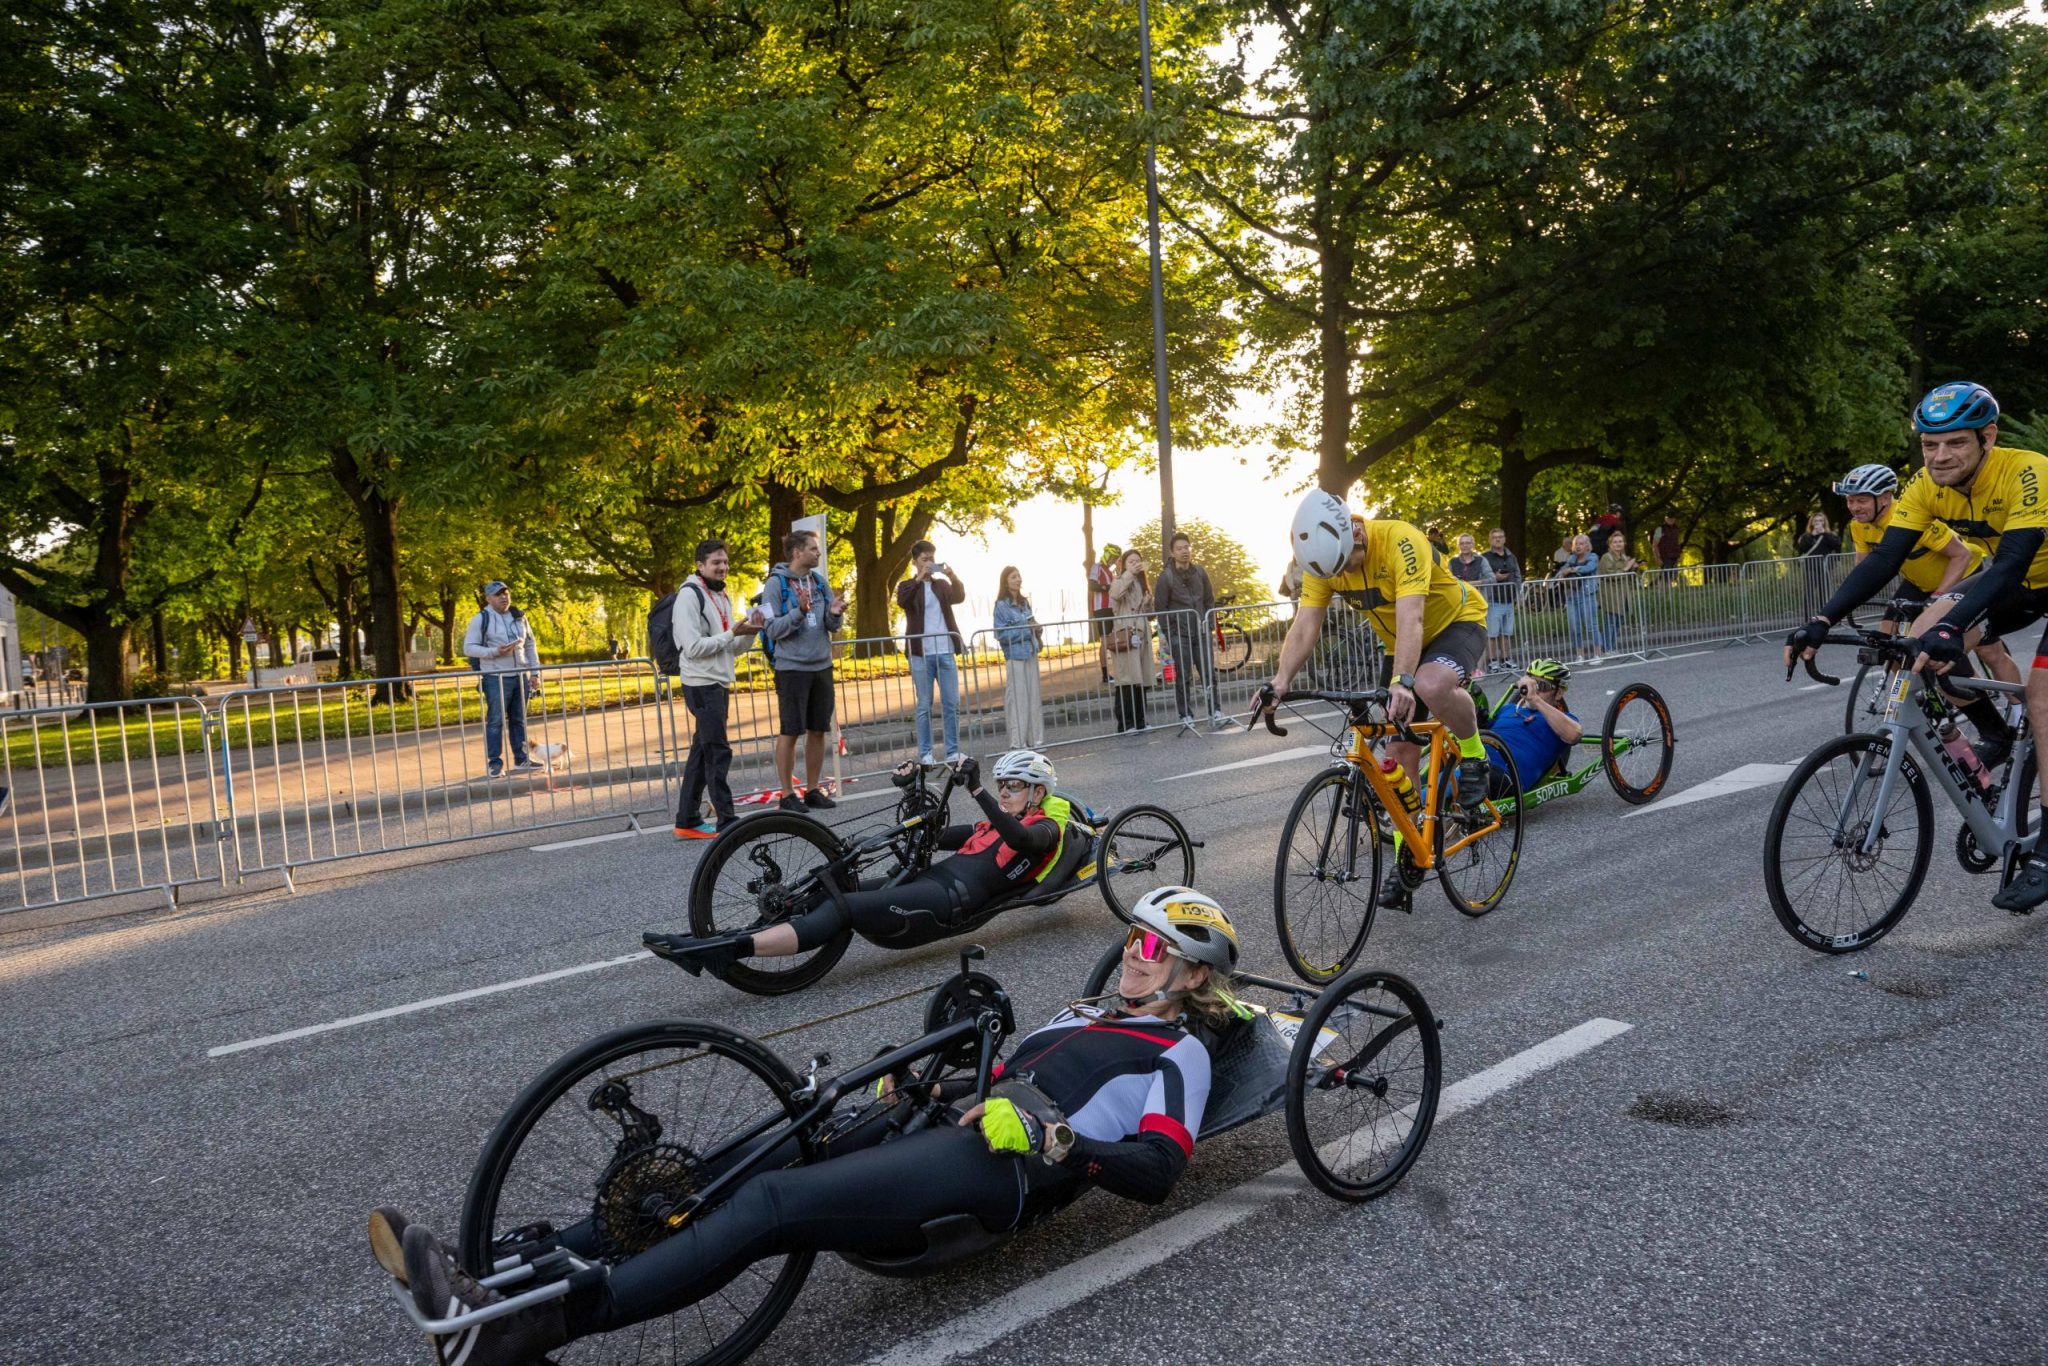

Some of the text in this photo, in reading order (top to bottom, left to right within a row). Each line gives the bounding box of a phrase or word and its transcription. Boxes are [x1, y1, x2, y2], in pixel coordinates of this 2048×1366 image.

[2019, 465, 2039, 507] GUIDE
[1397, 537, 1418, 576] GUIDE
[1925, 722, 1982, 805] TREK
[1535, 781, 1569, 805] SOPUR
